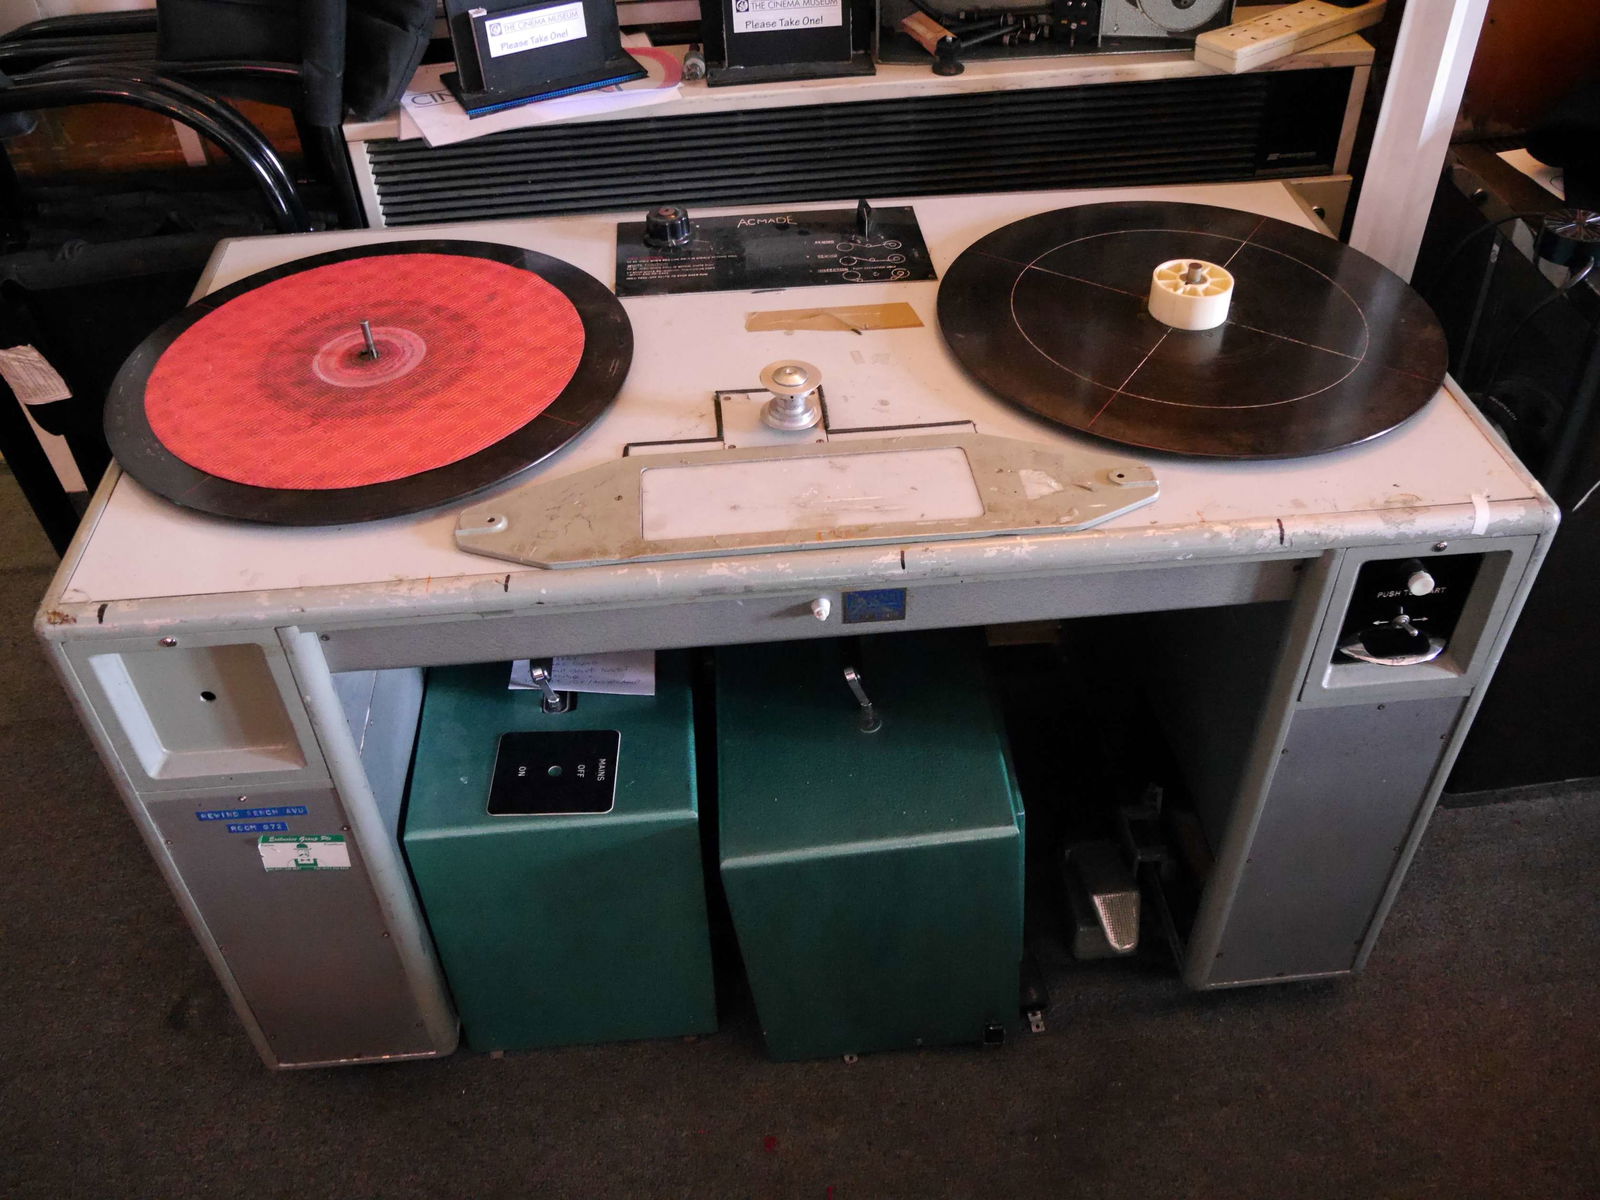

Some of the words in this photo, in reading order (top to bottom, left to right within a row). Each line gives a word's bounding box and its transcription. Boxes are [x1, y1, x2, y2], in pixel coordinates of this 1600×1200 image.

[751, 1, 765, 10] THE
[768, 0, 800, 9] CINEMA
[745, 20, 777, 30] Please
[779, 17, 800, 27] Take
[802, 15, 824, 26] One!
[500, 39, 529, 51] Please
[529, 33, 549, 45] Take
[549, 28, 569, 41] One!
[737, 215, 798, 229] ACMADE
[1377, 590, 1402, 598] PUSH
[518, 766, 527, 777] ON
[577, 764, 586, 778] OFF
[597, 758, 607, 781] MAINS
